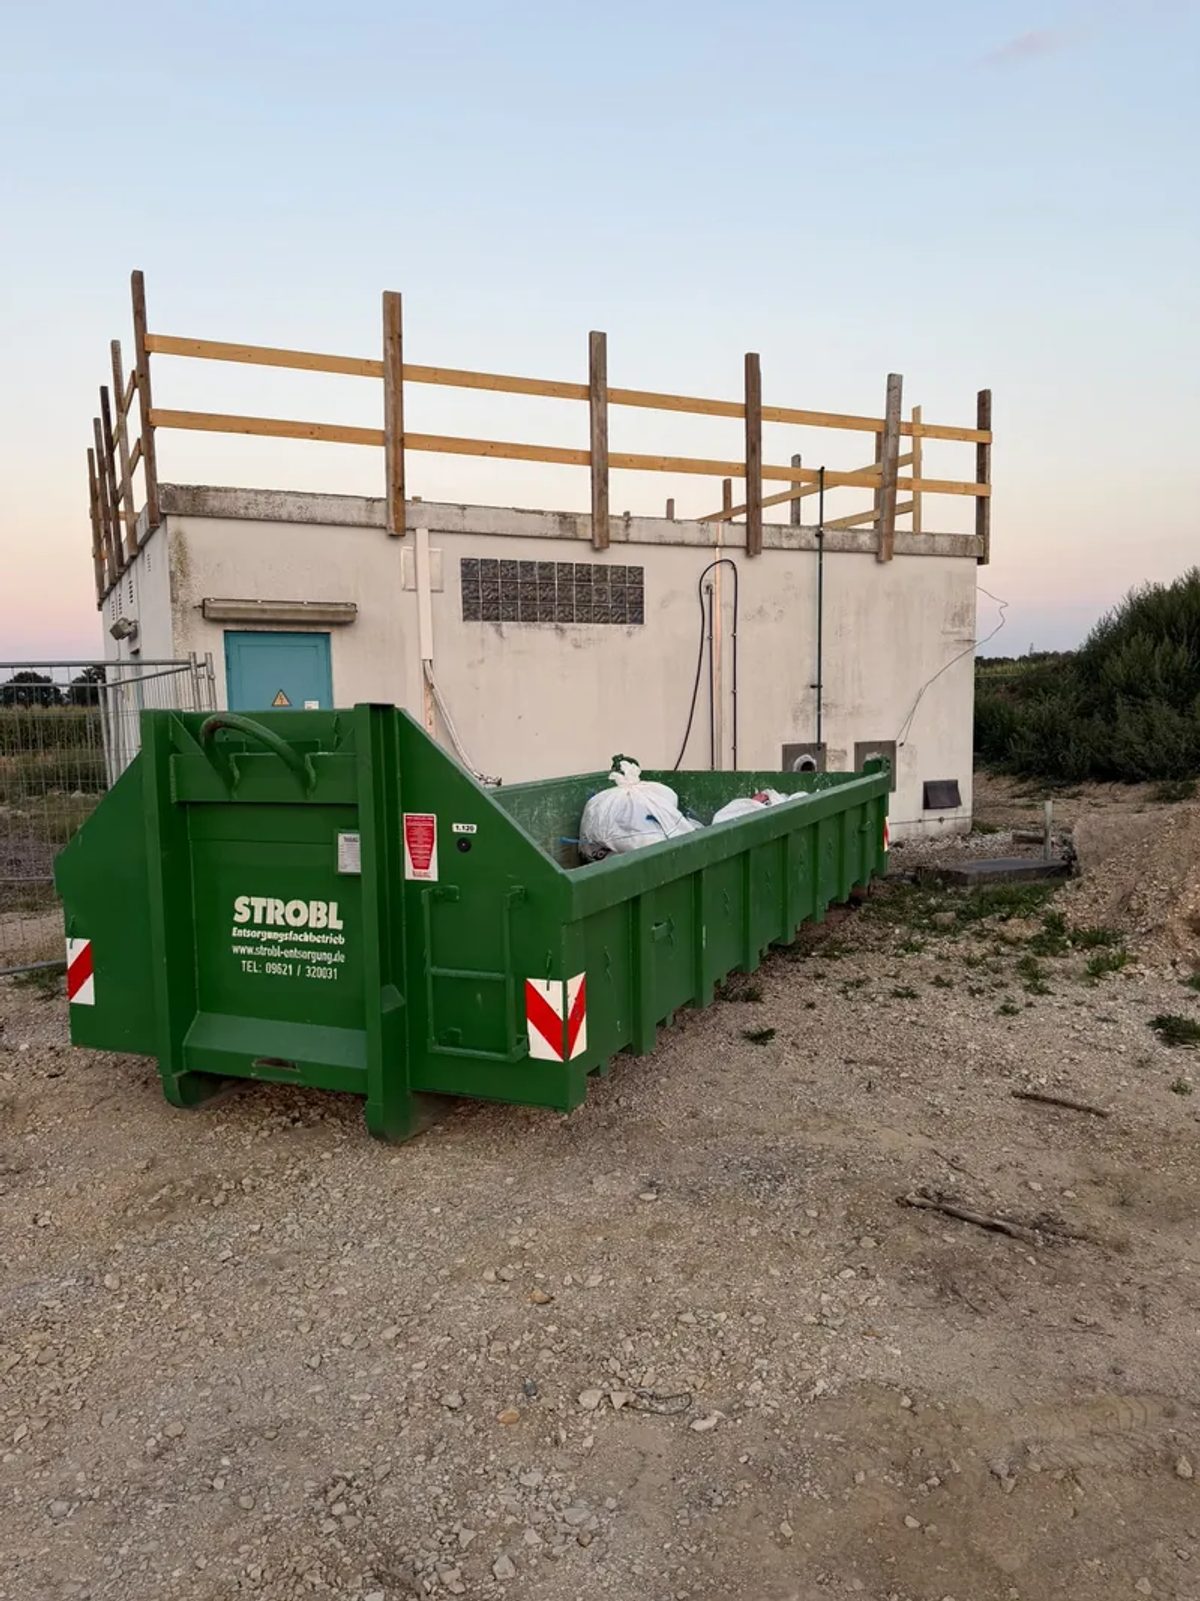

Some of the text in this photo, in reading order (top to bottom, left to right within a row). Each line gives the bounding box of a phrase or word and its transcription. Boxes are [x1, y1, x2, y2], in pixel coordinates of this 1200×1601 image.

[233, 896, 343, 930] STROBL
[232, 927, 345, 945] Entsorgungsfachbetrieb
[232, 945, 345, 964] www.strobl-entsorgung.de
[241, 960, 262, 973] TEL:
[265, 962, 293, 976] 09621
[296, 964, 302, 976] /
